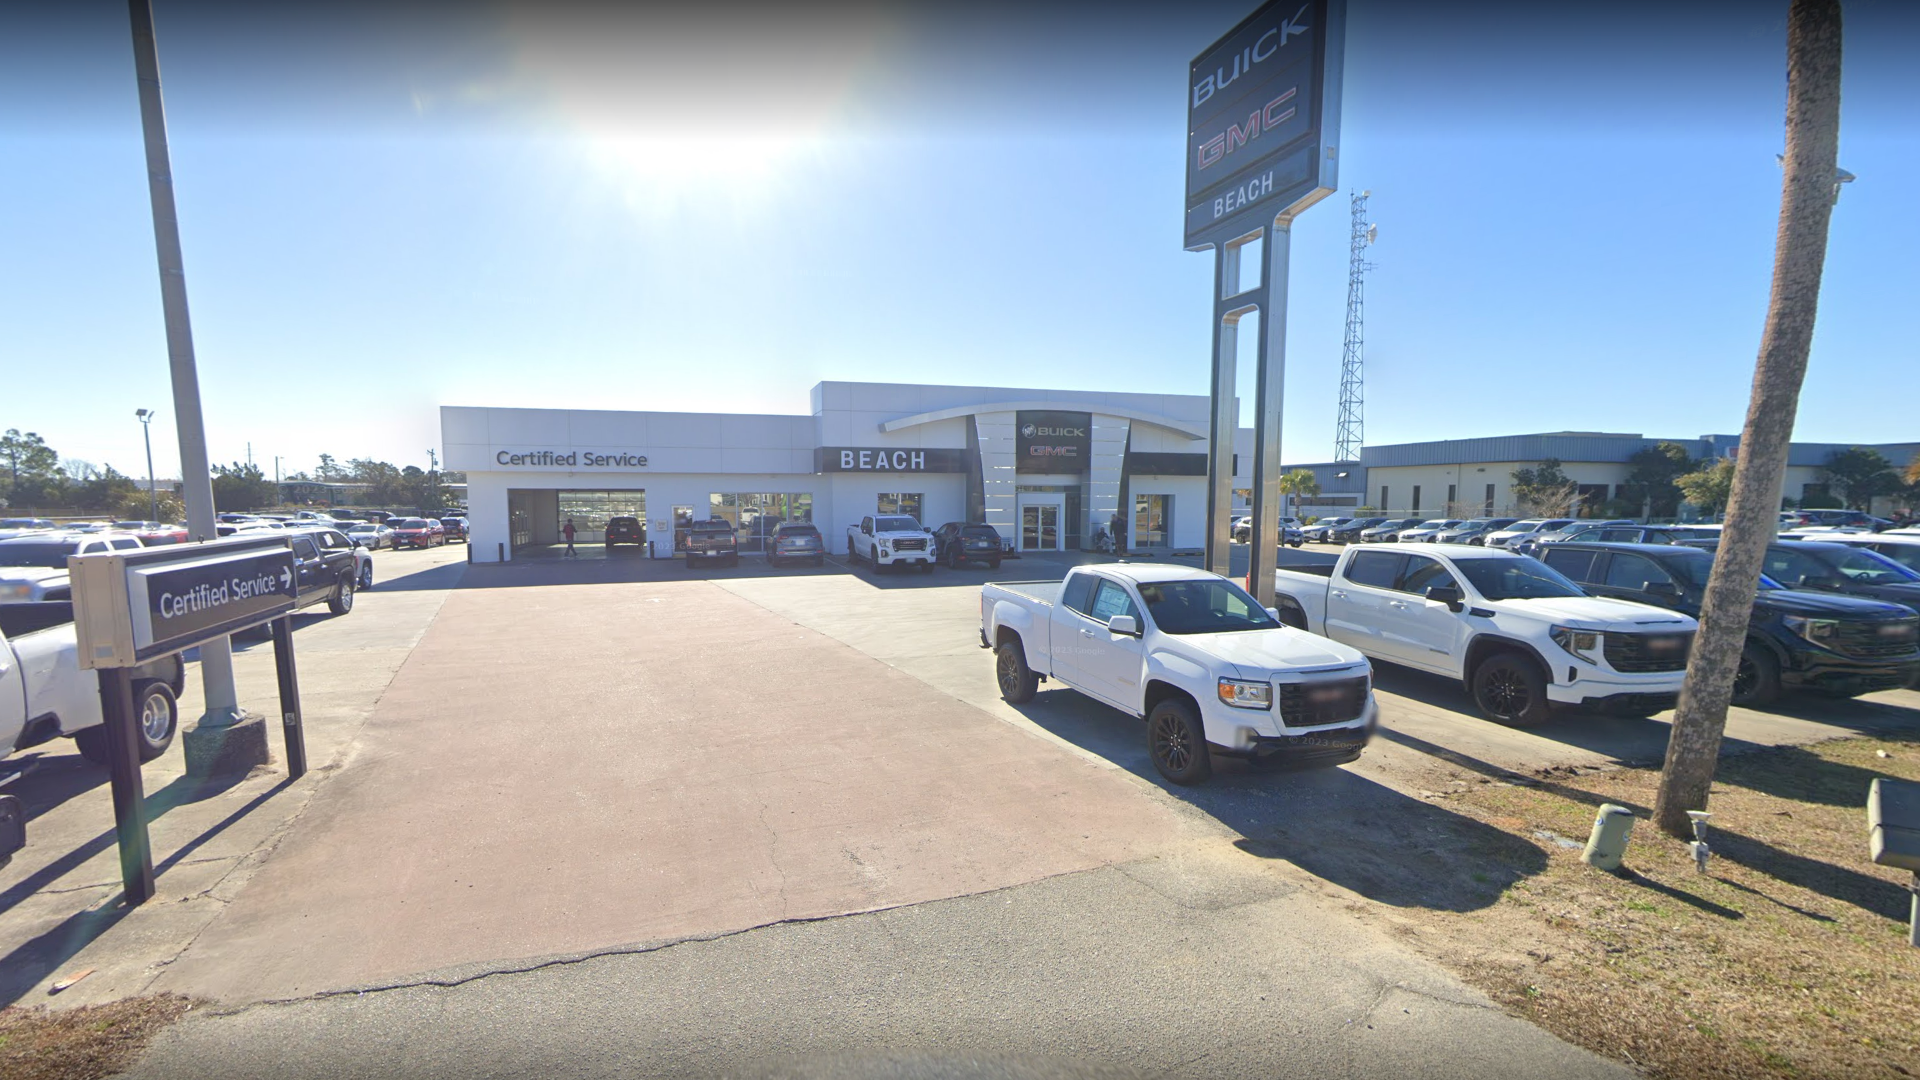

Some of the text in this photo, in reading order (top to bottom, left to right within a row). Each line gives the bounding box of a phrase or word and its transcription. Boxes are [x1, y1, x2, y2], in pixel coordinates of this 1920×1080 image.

[1193, 3, 1310, 108] BUICK
[1198, 86, 1297, 171] GMC
[1213, 171, 1274, 219] BEACH
[1037, 427, 1085, 437] BUICK
[496, 450, 648, 467] Certified Service
[840, 450, 925, 470] BEACH
[1030, 445, 1077, 457] GMC
[160, 572, 276, 619] Certified Service
